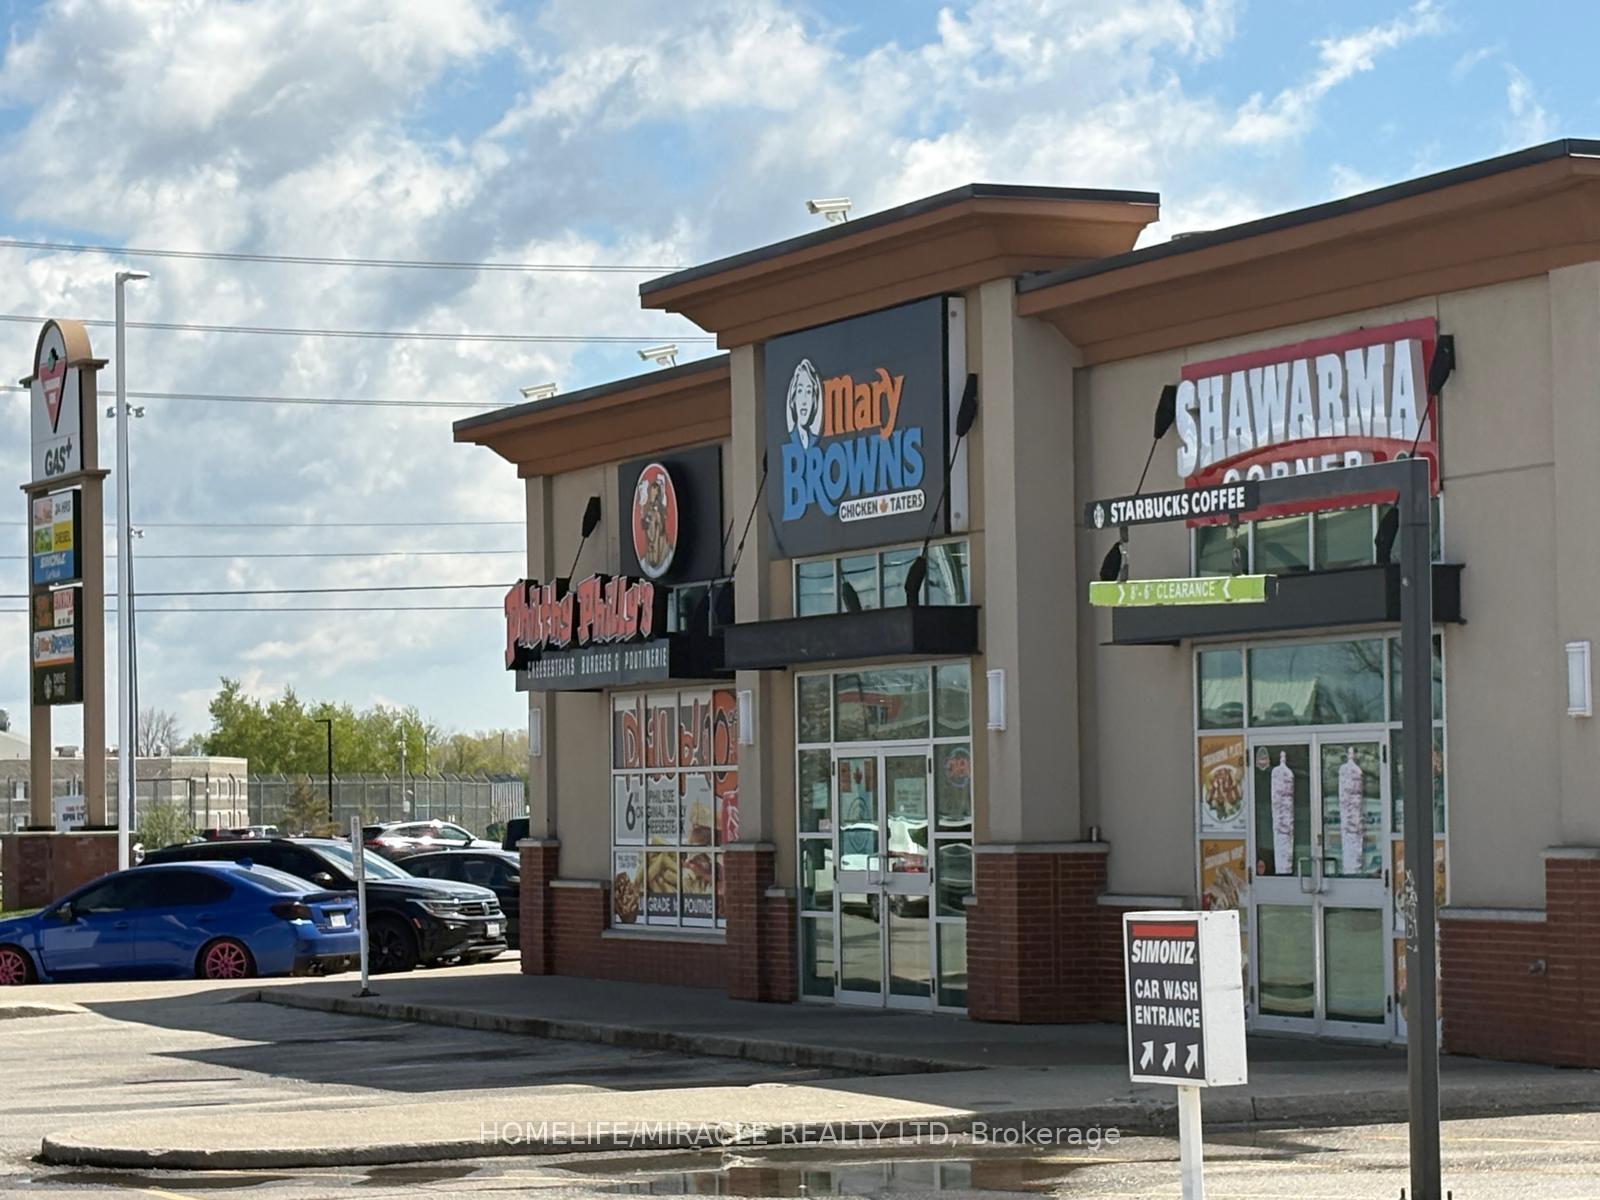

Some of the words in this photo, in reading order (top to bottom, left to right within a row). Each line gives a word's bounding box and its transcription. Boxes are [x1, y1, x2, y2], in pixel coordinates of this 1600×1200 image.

[1175, 339, 1420, 478] SHAWARMA
[840, 500, 878, 519] CHICKEN
[890, 492, 923, 511] TATERS
[1111, 493, 1189, 523] STARBUCKS
[1192, 487, 1245, 514] COFFEE
[1156, 581, 1215, 598] CLEARANCE
[624, 646, 667, 670] POUTINERIE
[1131, 939, 1195, 965] SIMONIZ
[1135, 979, 1160, 999] CAR
[1163, 980, 1198, 1001] WASH
[1135, 1005, 1201, 1028] ENTRANCE
